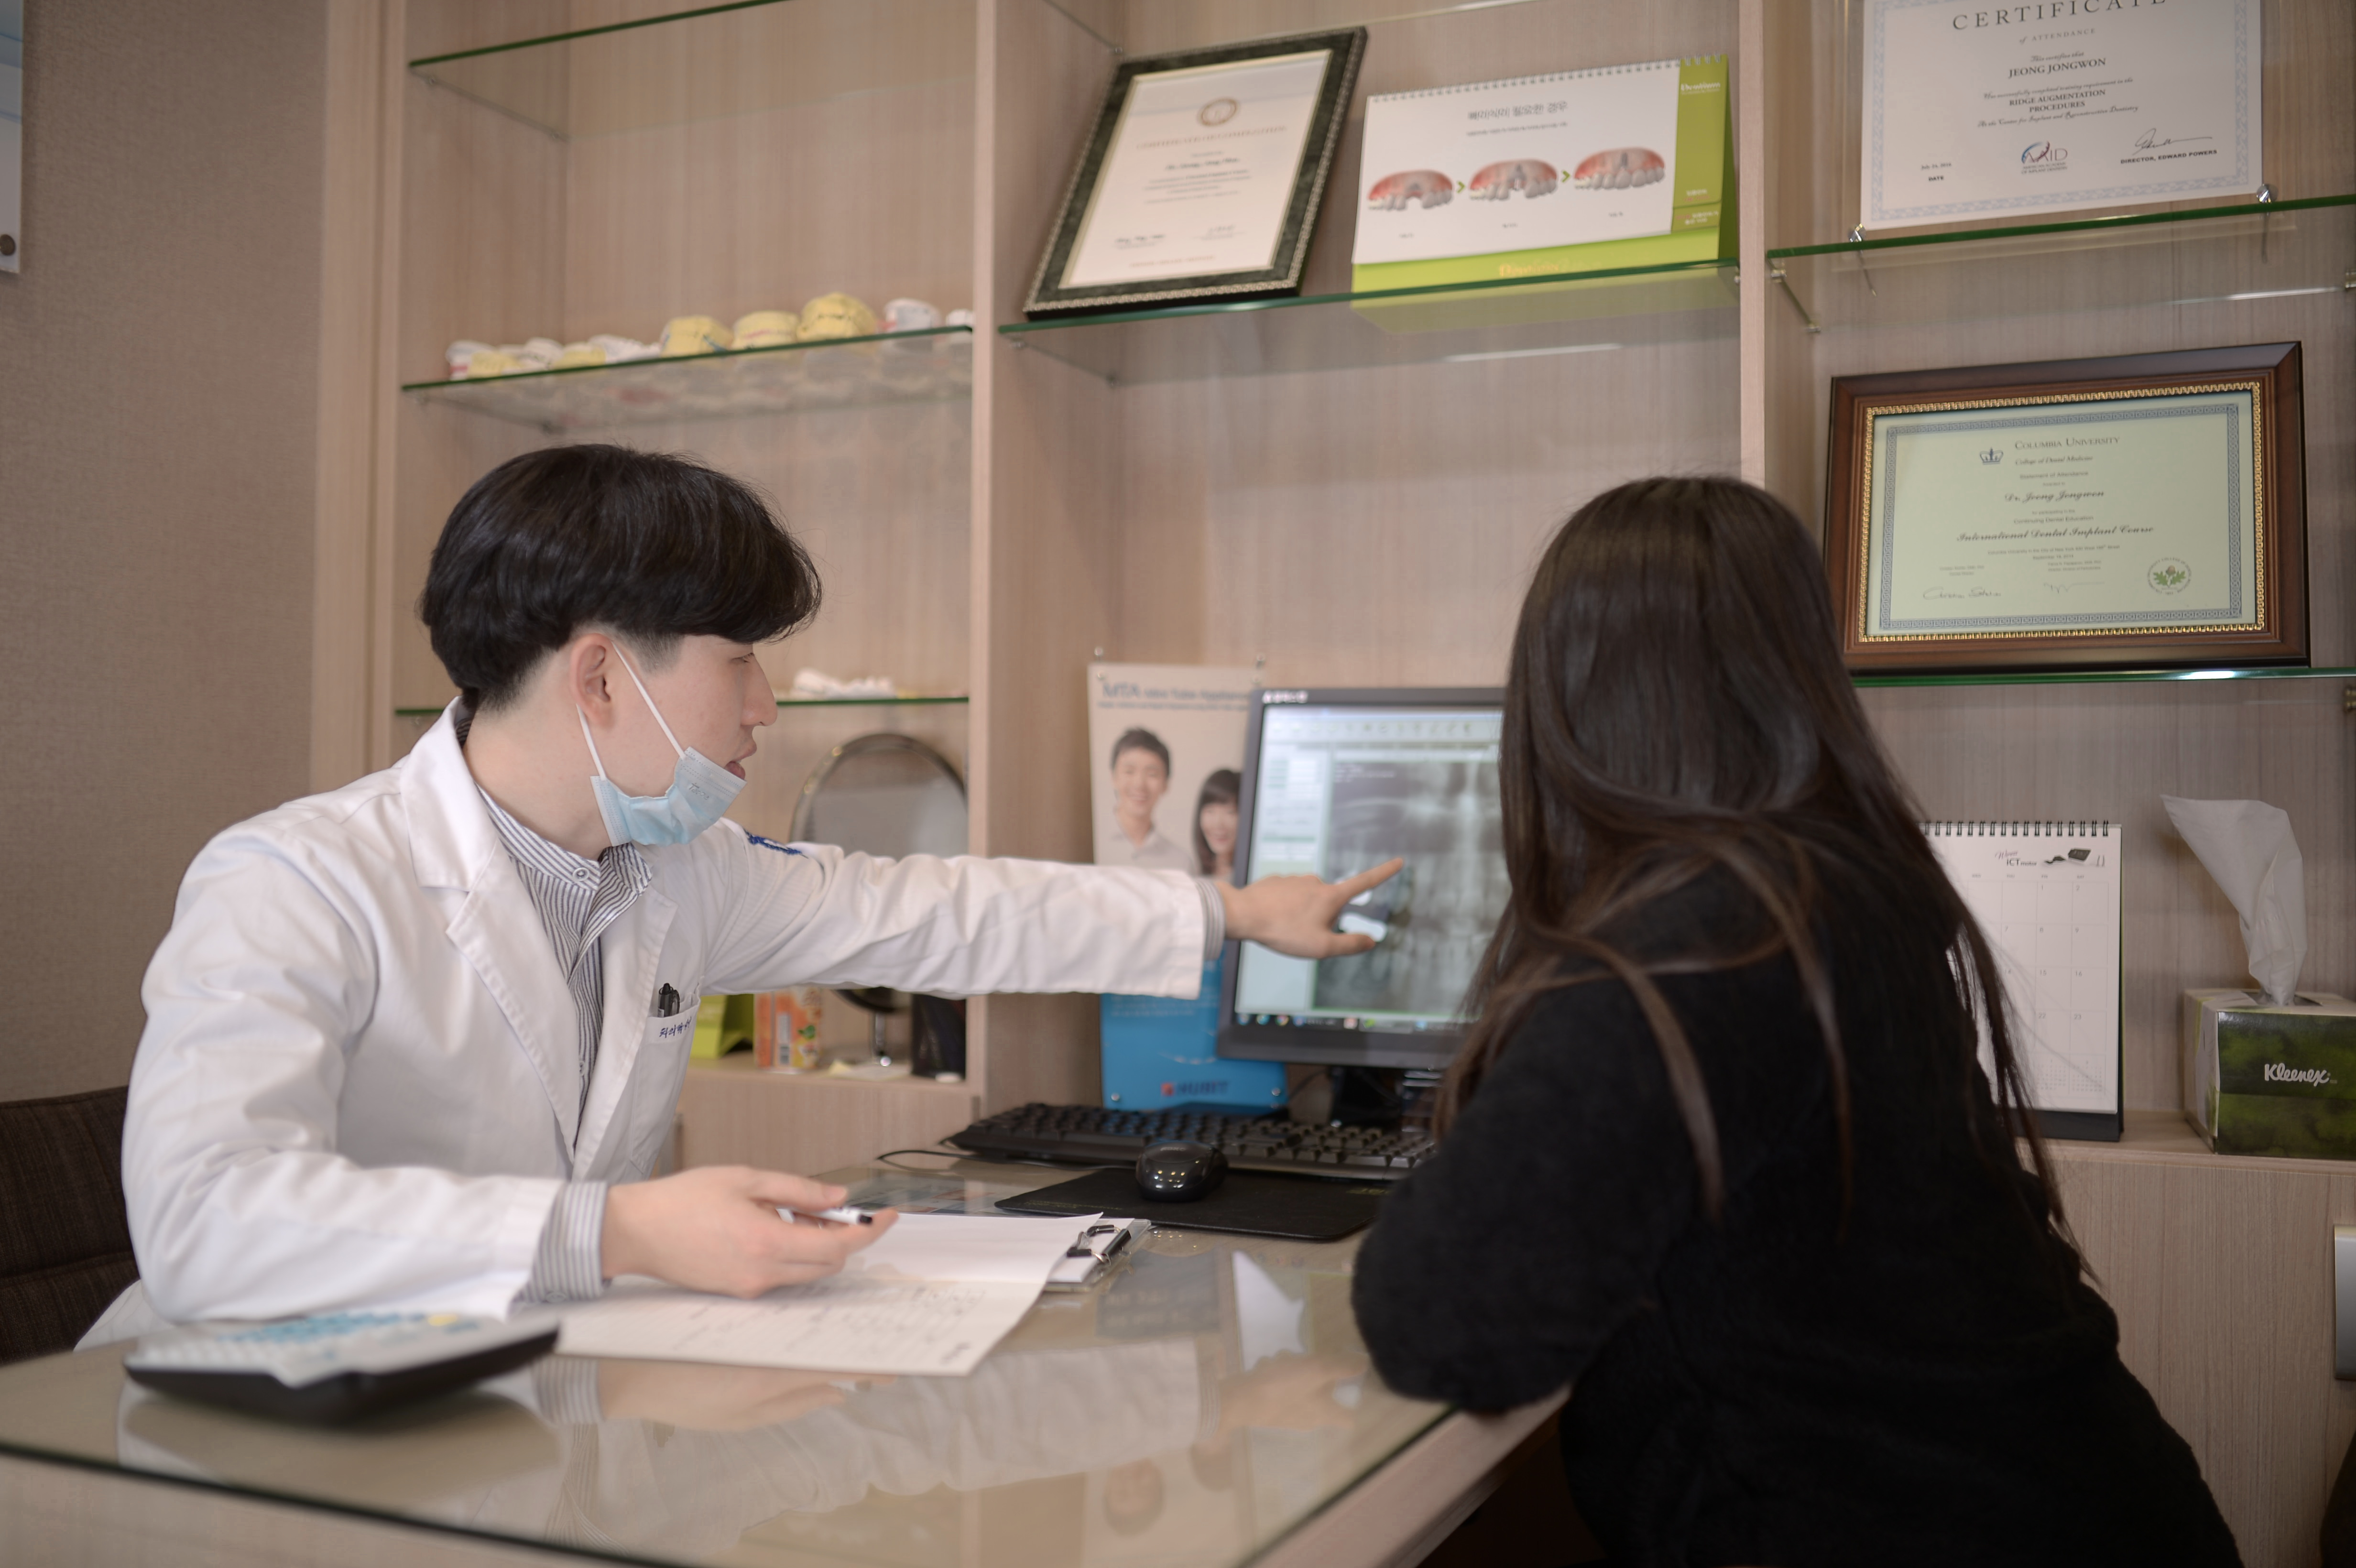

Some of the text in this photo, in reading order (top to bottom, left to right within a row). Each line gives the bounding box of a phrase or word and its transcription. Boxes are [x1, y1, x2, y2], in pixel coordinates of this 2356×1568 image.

[1952, 0, 2166, 30] CERTIFICA
[2031, 28, 2096, 42] ATTENDANCE
[2008, 58, 2106, 79] JEONG JONGWON
[2009, 89, 2106, 106] RIDGE AUGMENTATION
[2029, 100, 2086, 113] PROCEDURES
[2158, 152, 2187, 161] EDWARD
[2188, 149, 2217, 157] POWERS
[2264, 1062, 2330, 1087] Kleenex
